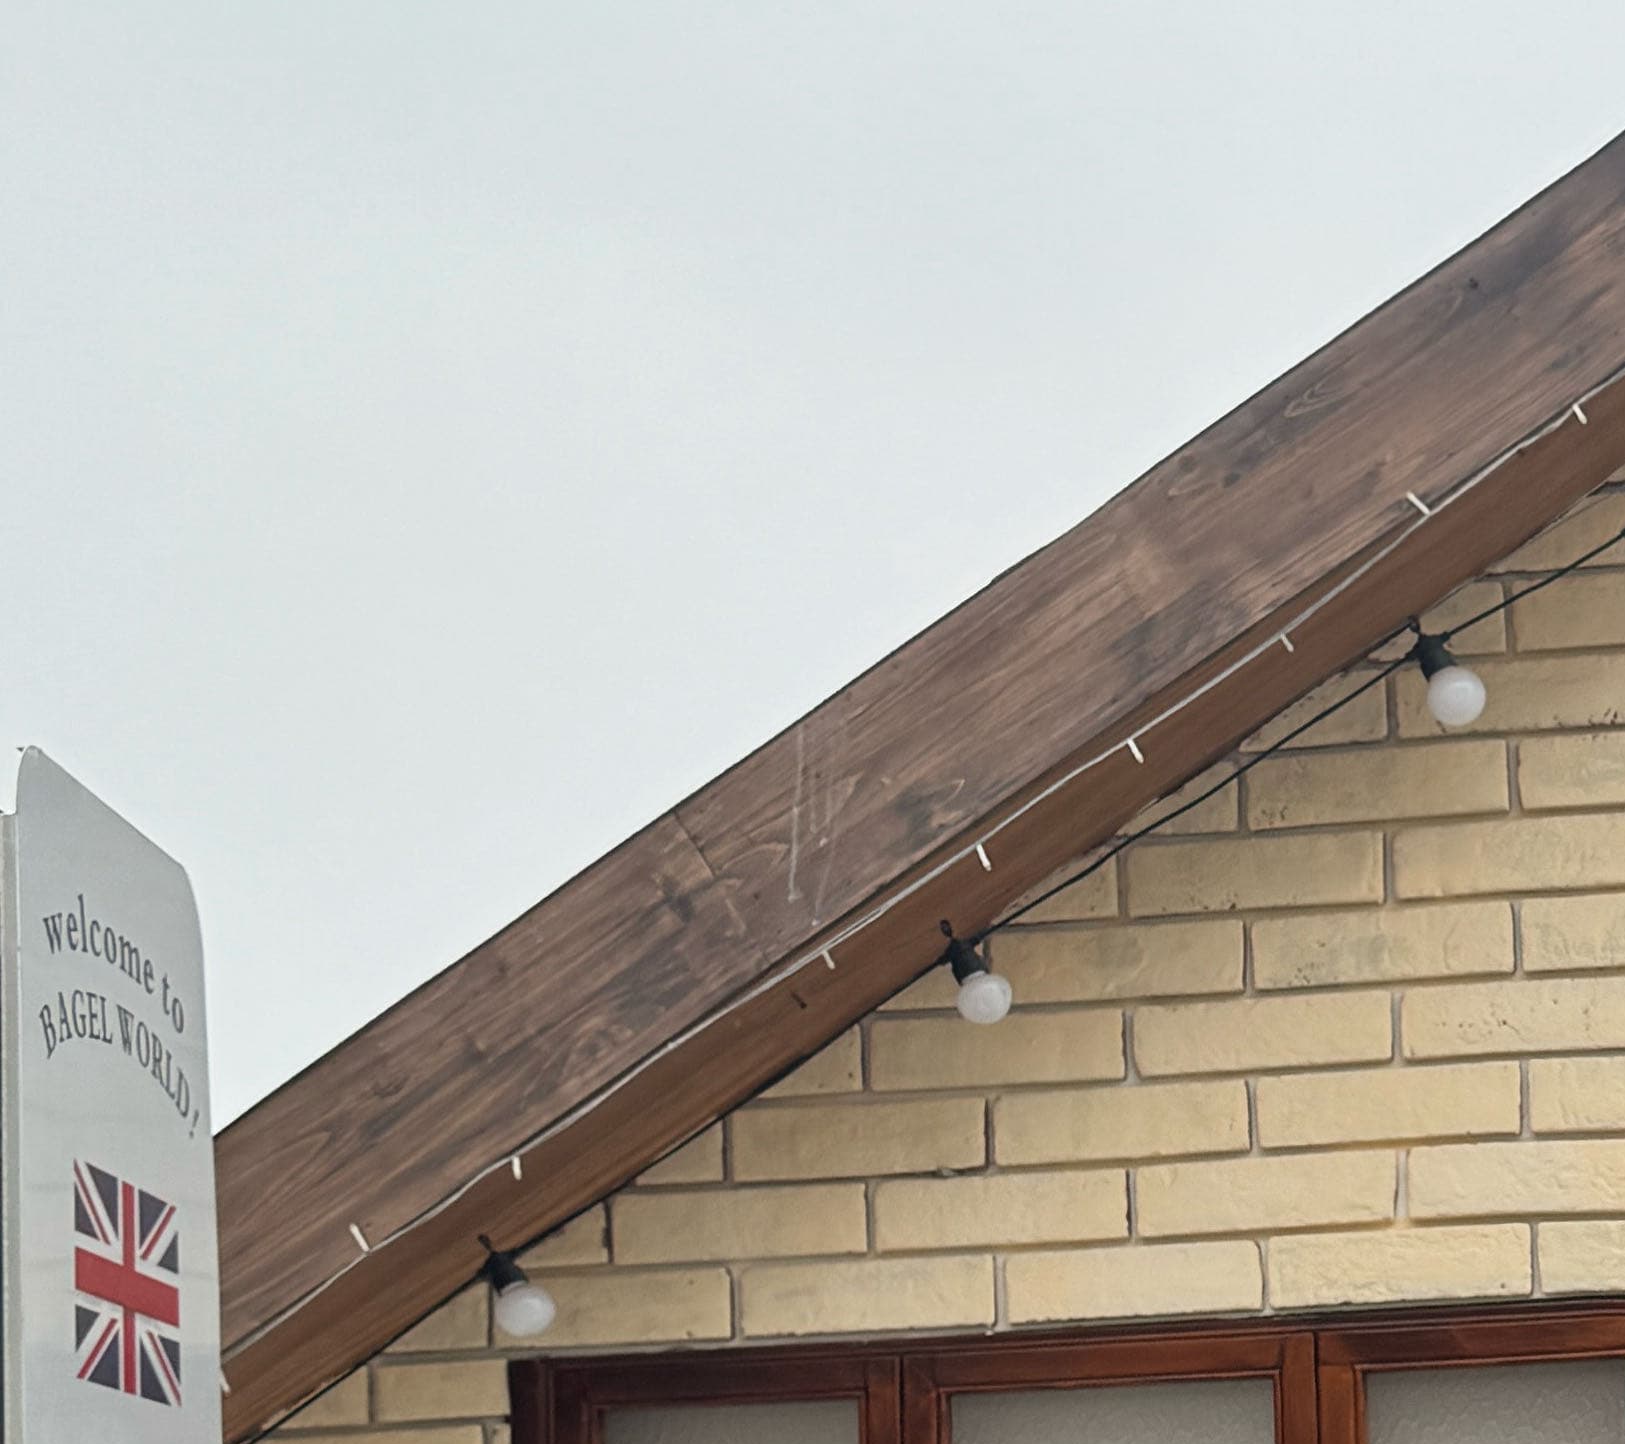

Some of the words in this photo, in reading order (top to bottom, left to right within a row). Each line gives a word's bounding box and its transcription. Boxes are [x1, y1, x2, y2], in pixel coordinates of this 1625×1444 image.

[43, 893, 154, 995] welcome
[162, 972, 185, 1034] to
[39, 989, 113, 1060] BAGEL
